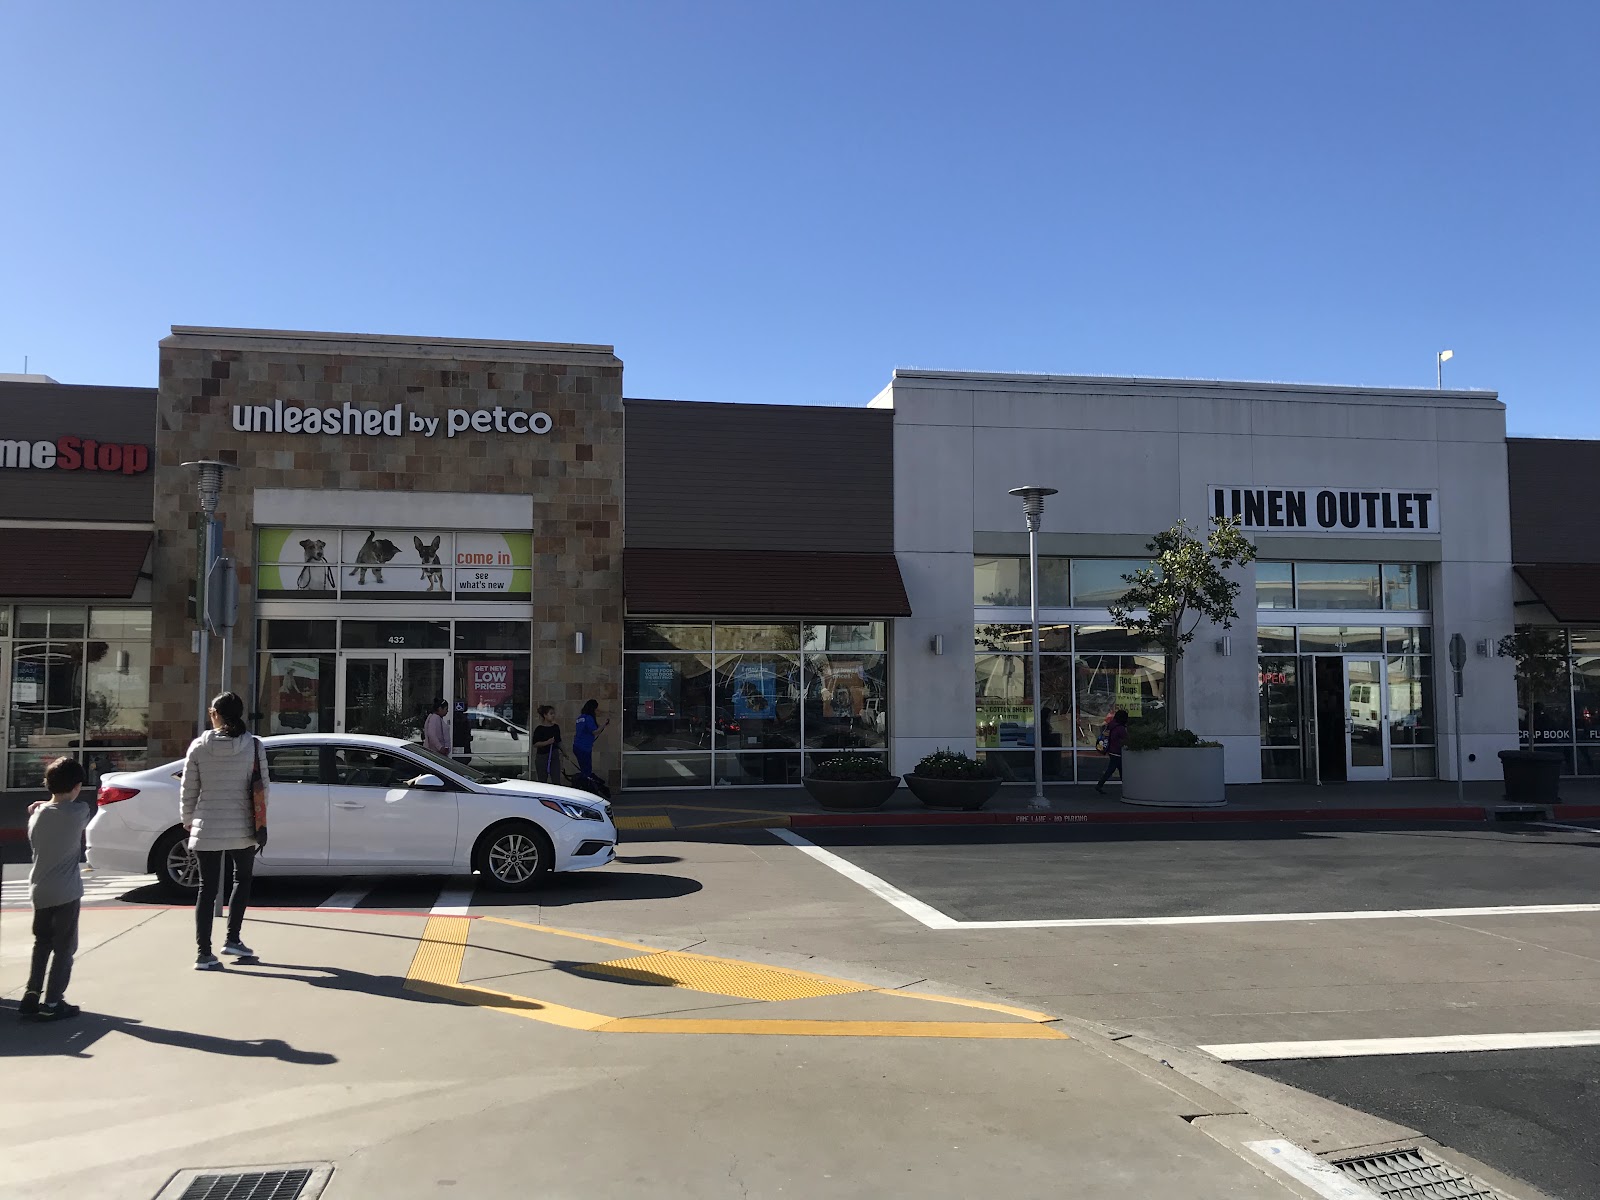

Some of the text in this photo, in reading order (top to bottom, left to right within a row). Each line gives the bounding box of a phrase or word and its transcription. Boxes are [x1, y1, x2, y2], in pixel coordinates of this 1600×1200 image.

[232, 399, 553, 437] unleashed by petco
[1214, 489, 1432, 528] LINEN OUTLET
[457, 550, 511, 565] come in
[475, 572, 489, 580] see
[459, 580, 486, 589] what's
[388, 636, 405, 644] 432
[474, 672, 507, 683] LOW
[1258, 673, 1287, 684] OPEN
[1120, 685, 1138, 695] Rugs
[1543, 730, 1570, 739] BOOK
